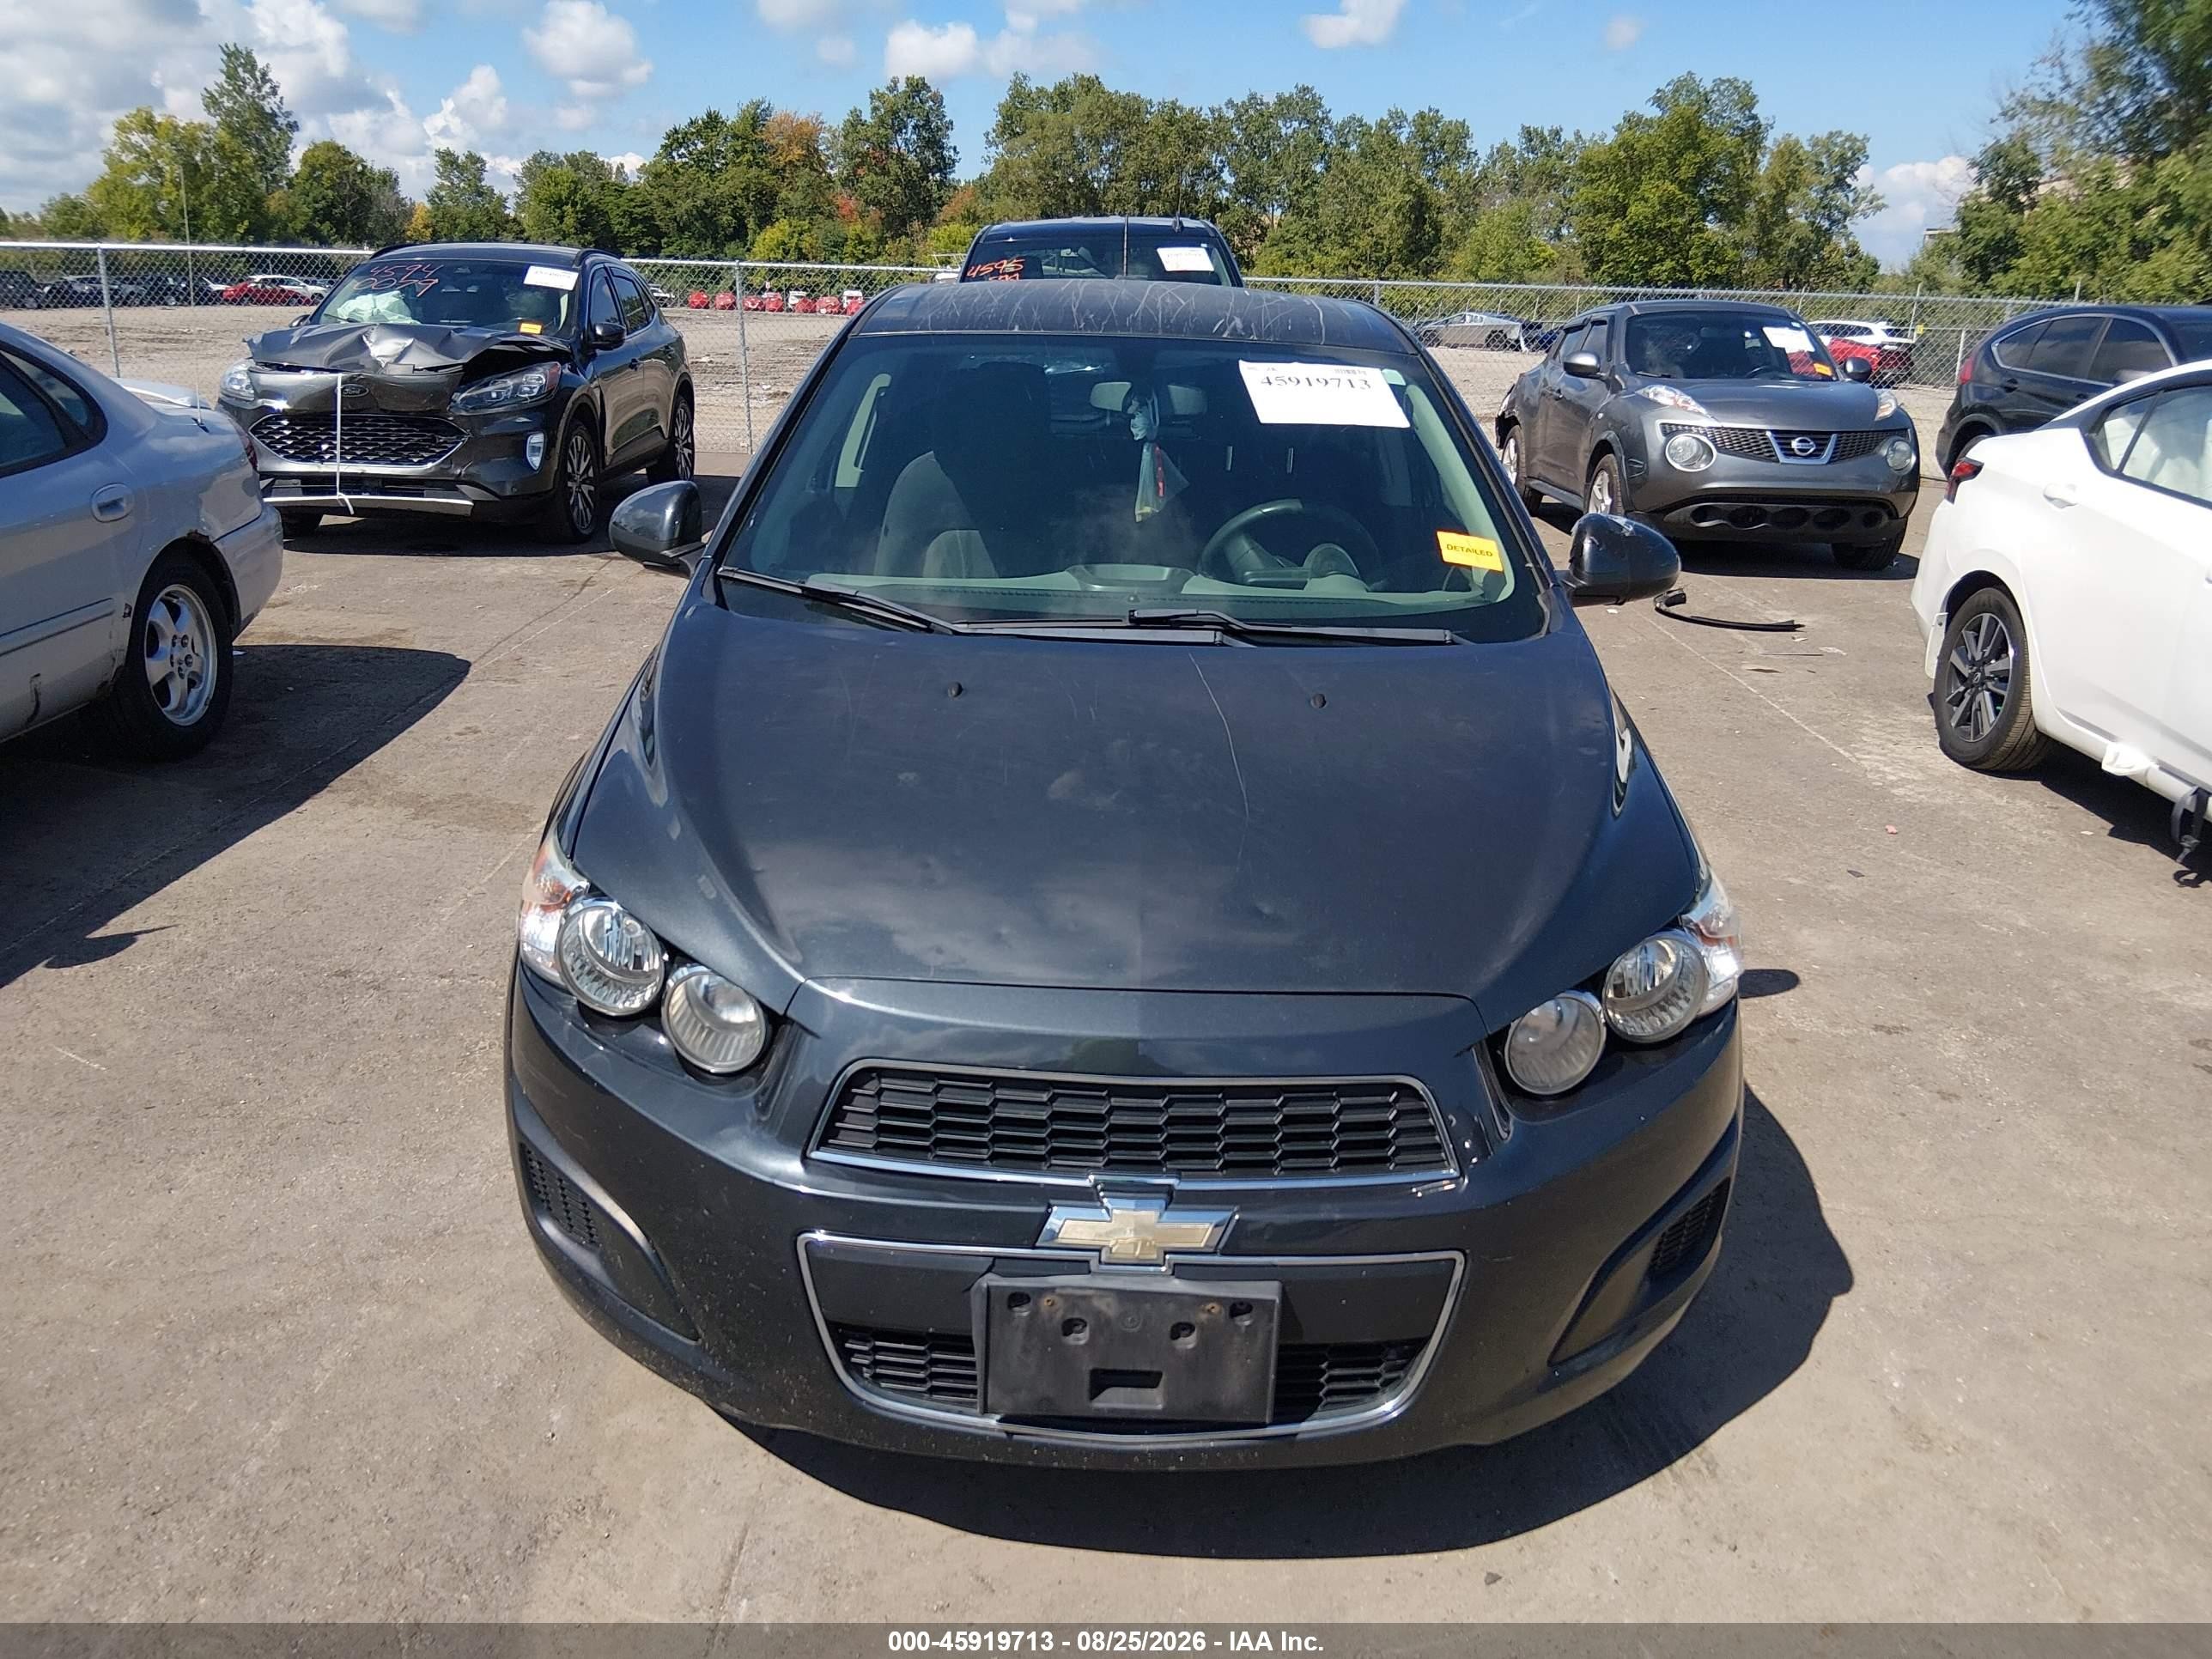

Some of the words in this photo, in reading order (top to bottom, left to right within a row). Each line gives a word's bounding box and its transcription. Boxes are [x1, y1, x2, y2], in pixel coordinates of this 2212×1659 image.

[370, 264, 445, 281] 4594
[966, 258, 1025, 278] 4595
[1261, 374, 1371, 390] 45919713
[1446, 544, 1493, 557] DETAILED
